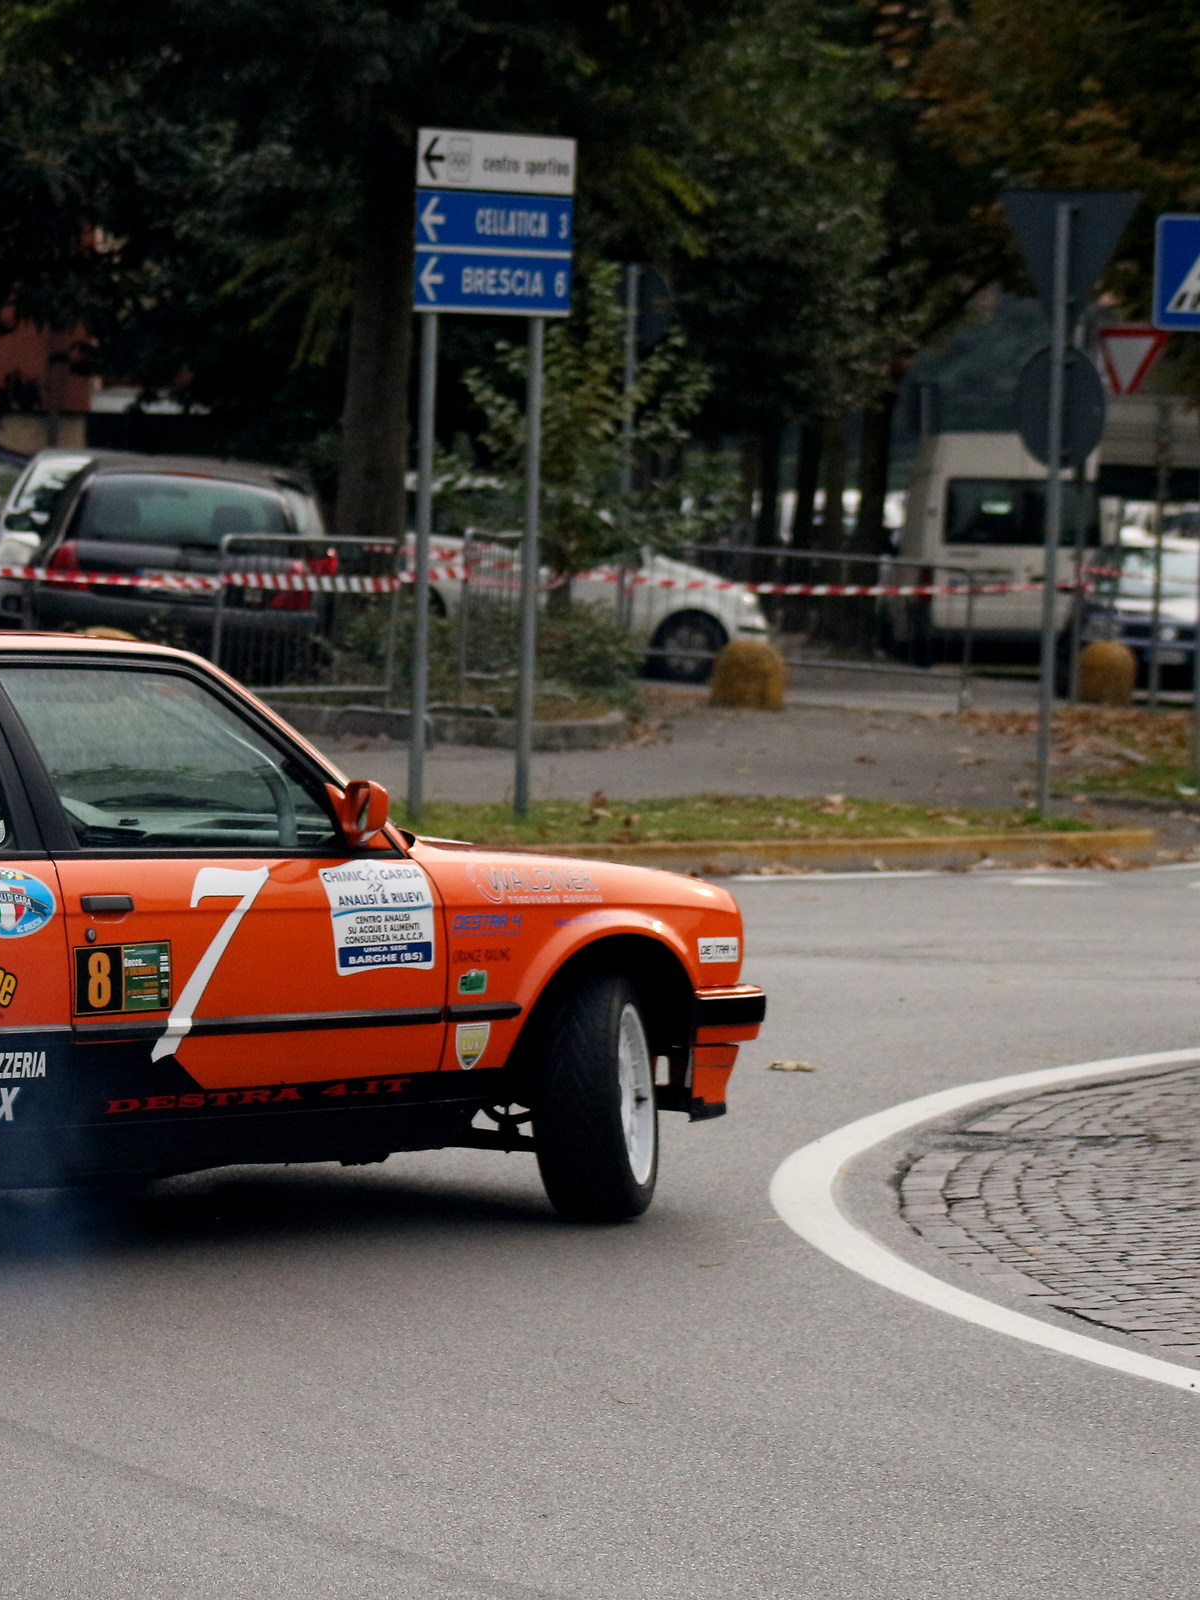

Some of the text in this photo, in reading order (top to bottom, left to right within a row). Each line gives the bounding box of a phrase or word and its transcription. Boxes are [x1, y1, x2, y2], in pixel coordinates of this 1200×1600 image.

[482, 156, 570, 179] centro sportivo
[475, 208, 569, 239] CELLATICA 3
[461, 266, 566, 298] BRESCIA 6
[322, 868, 422, 883] CHIMIC GARDA
[479, 868, 600, 893] WALDNER
[14, 894, 33, 907] GARA
[338, 891, 425, 907] ANALISI & RILIEVI
[355, 913, 411, 925] CENTRO ANALISI
[452, 913, 523, 930] DESTRA 4
[348, 926, 357, 935] SU
[359, 925, 382, 934] ACQUE
[389, 922, 420, 932] ALIMENTI
[344, 934, 391, 945] CONSULENZA
[363, 944, 408, 953] UNICA SEDE
[700, 944, 730, 956] DETRA
[151, 865, 271, 1063] 7
[348, 951, 423, 965] BARGHE (BS)
[88, 951, 112, 1009] 8
[463, 1040, 480, 1051] LUX
[103, 1078, 413, 1115] DESTRA 4.IT
